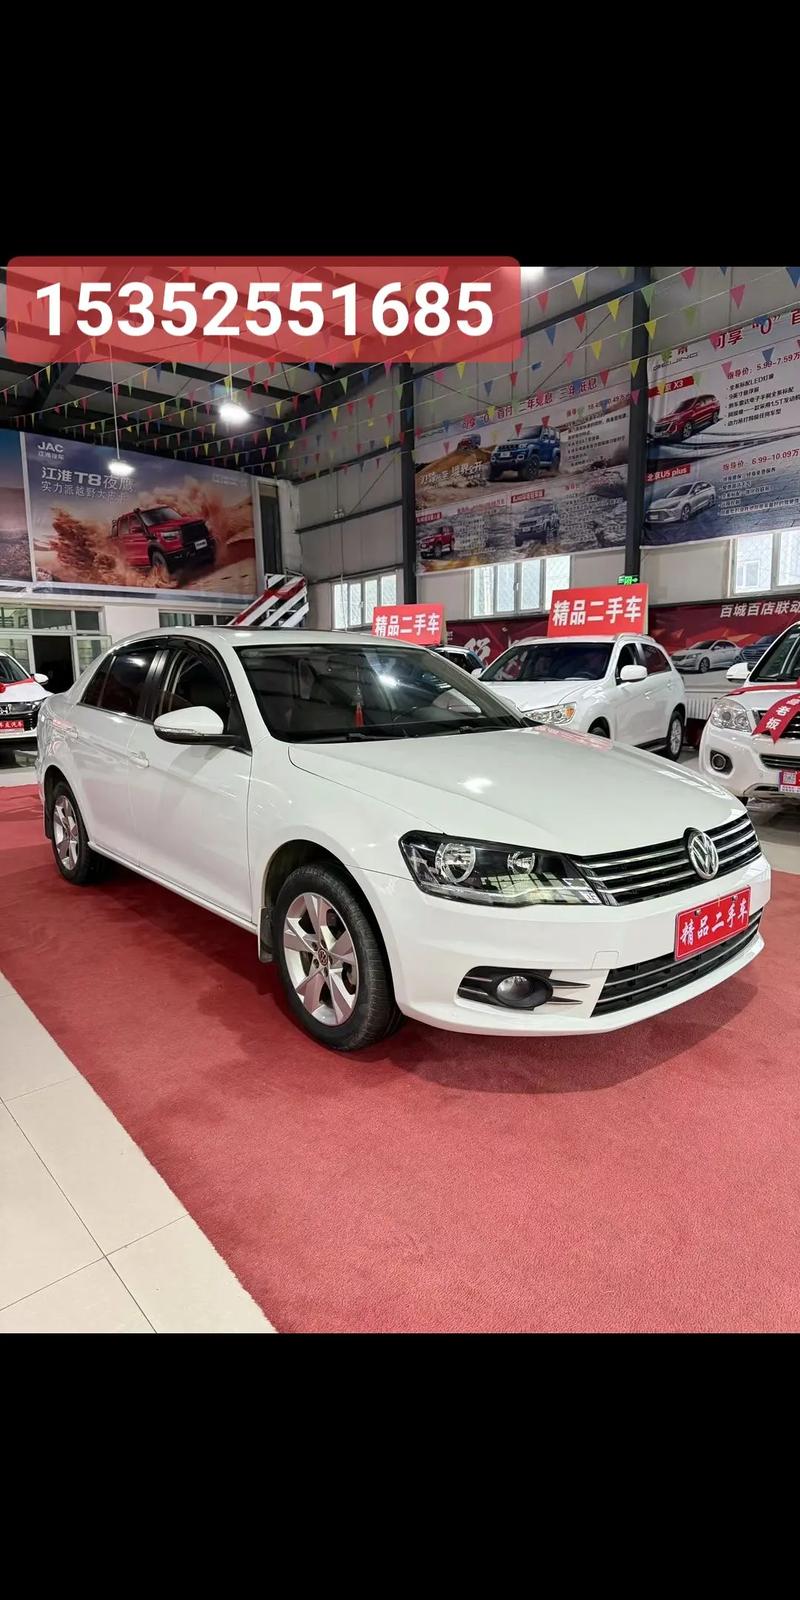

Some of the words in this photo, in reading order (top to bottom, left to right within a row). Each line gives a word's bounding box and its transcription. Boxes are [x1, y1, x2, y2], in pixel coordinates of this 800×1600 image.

[37, 441, 64, 453] JAC
[551, 596, 643, 627] 精品二手车
[719, 601, 800, 618] 百城百店联动
[374, 612, 441, 638] 精品二手车
[680, 898, 749, 946] 精品二手车
